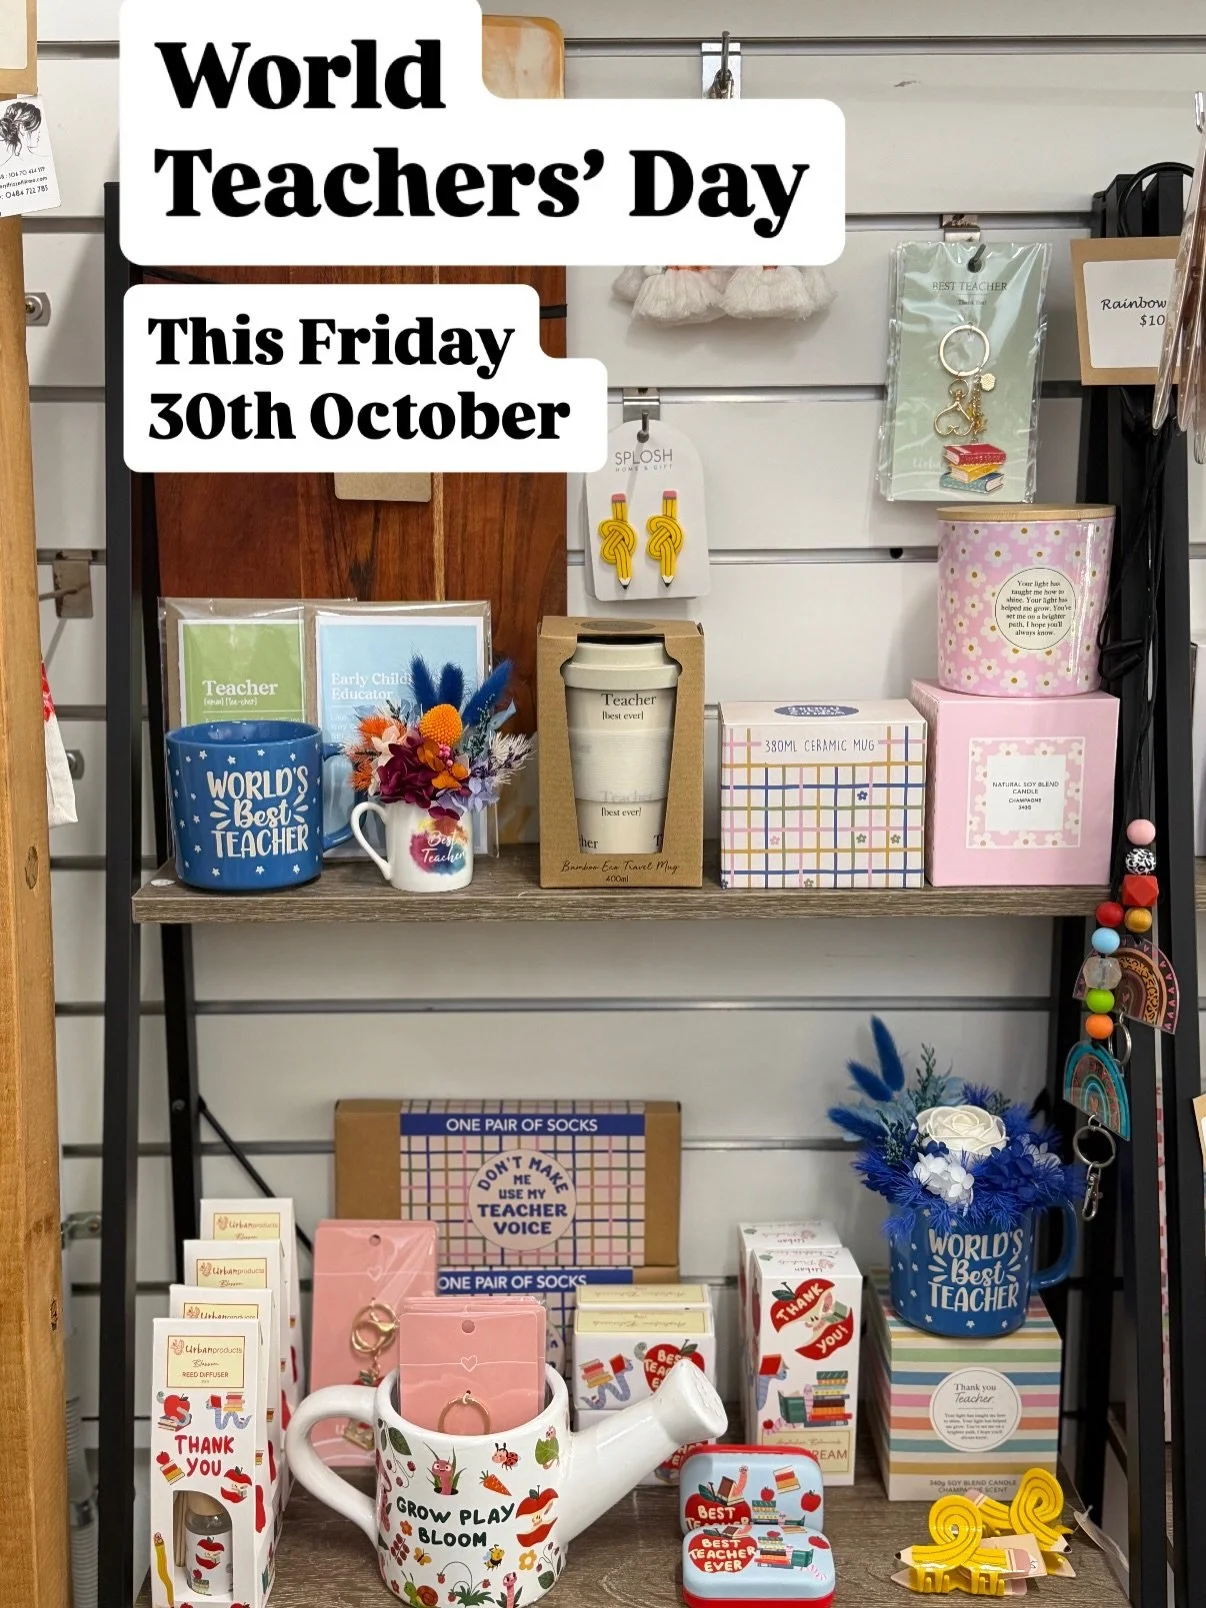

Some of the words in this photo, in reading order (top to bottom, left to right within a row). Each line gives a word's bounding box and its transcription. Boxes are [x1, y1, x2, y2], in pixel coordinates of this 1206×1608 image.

[933, 281, 955, 290] BEST
[960, 281, 1008, 291] TEACHER
[1100, 296, 1167, 310] Rainbow
[615, 449, 672, 466] SPLOSH
[331, 672, 368, 687] Early
[202, 680, 278, 696] Teacher
[332, 688, 393, 700] Educator
[601, 693, 657, 706] Teacher
[765, 740, 797, 752] 380ML
[805, 740, 847, 752] CERAMIC
[854, 739, 875, 751] MUG
[206, 765, 308, 800] WORLD'S
[234, 799, 291, 828] Best
[210, 824, 308, 858] TEACHER
[428, 828, 456, 848] Best
[421, 848, 464, 863] Teacher
[624, 860, 653, 871] Travel
[653, 860, 679, 875] Mug
[606, 875, 629, 883] 400ml
[446, 1118, 480, 1132] ONE
[485, 1118, 517, 1132] PAIR
[522, 1118, 542, 1132] OF
[547, 1118, 598, 1132] SOCKS
[478, 1156, 522, 1191] DON'T
[528, 1157, 569, 1194] MAKE
[513, 1175, 531, 1185] ME
[499, 1189, 523, 1199] USE
[528, 1189, 546, 1199] MY
[477, 1204, 568, 1217] TEACHER
[493, 1222, 551, 1234] VOICE
[928, 1228, 1024, 1261] WORLD'S
[951, 1257, 1005, 1287] Best
[438, 1276, 471, 1290] ONE
[475, 1276, 507, 1289] PAIR
[511, 1276, 533, 1289] OF
[537, 1275, 587, 1289] SOCKS
[776, 1283, 823, 1321] THANK
[928, 1280, 1020, 1312] TEACHER
[658, 1350, 690, 1365] BES
[644, 1359, 671, 1376] TEAC
[954, 1383, 980, 1392] Thank
[982, 1384, 997, 1392] you
[955, 1392, 995, 1403] Teacher
[174, 1435, 235, 1454] THANK
[810, 1449, 847, 1460] REAM
[186, 1458, 222, 1477] YOU
[396, 1496, 451, 1523] GROW
[460, 1503, 515, 1526] PLAY
[698, 1505, 736, 1520] BEST
[418, 1527, 487, 1547] BLOOM
[701, 1539, 741, 1548] BEST
[688, 1546, 757, 1560] TEACHER
[704, 1560, 743, 1572] EVER
